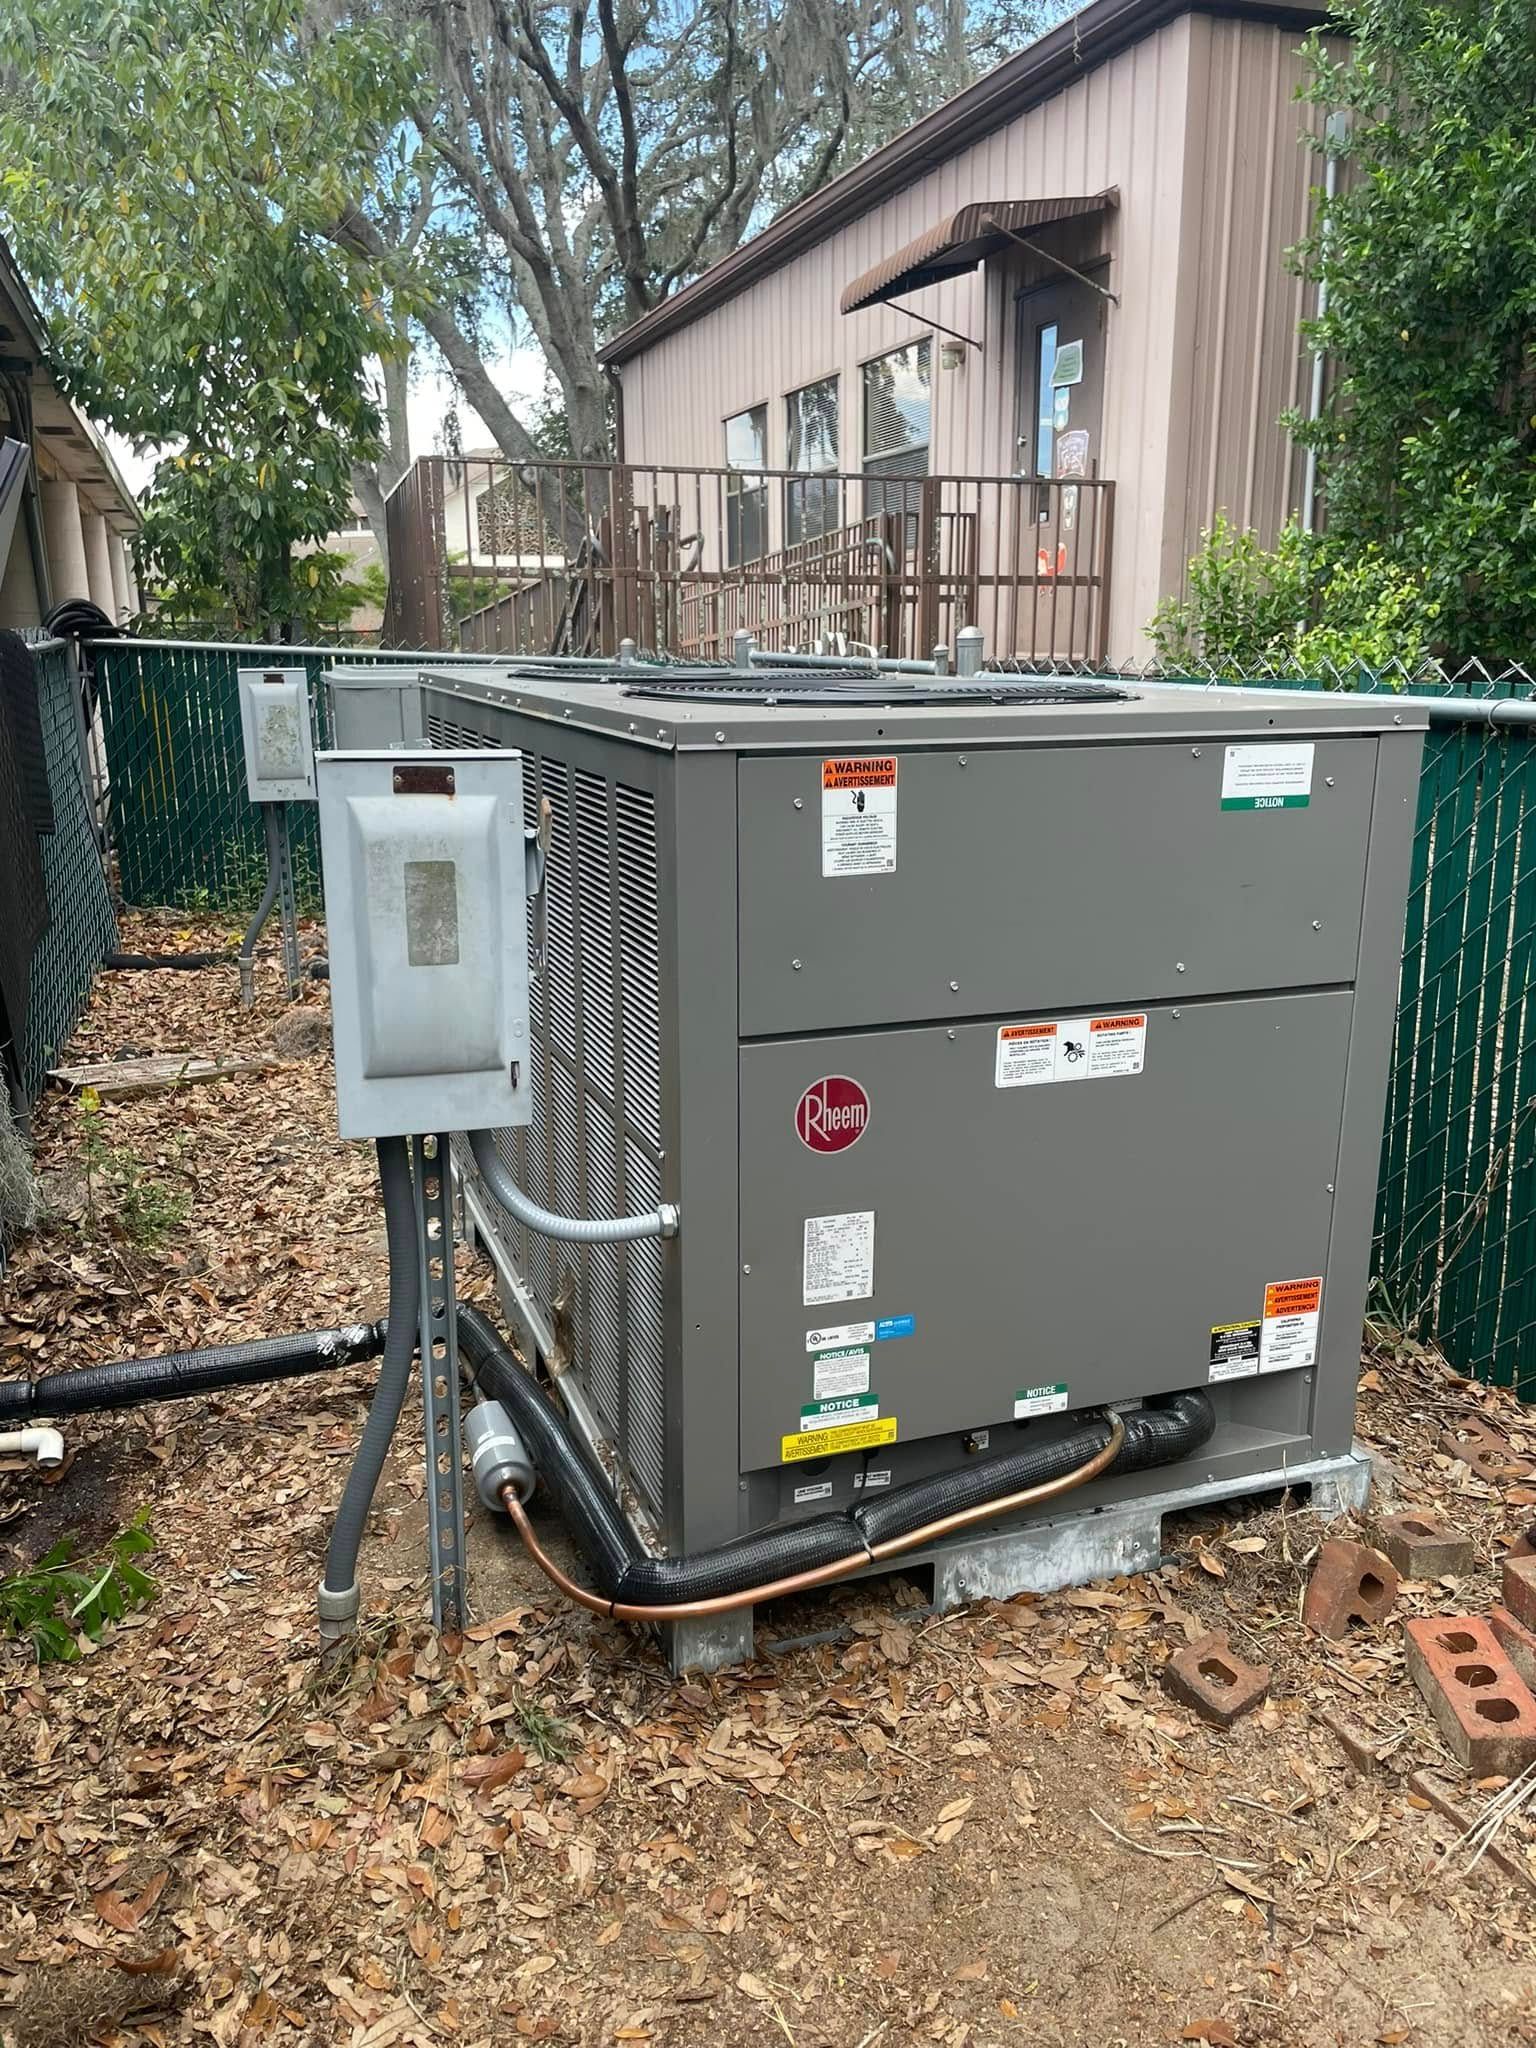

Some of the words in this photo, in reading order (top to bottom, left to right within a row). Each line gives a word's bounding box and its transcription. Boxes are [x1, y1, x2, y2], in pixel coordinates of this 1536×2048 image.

[834, 760, 893, 774] WARNING
[833, 774, 895, 788] AVERTISSEMENT
[1254, 796, 1284, 809] NOTICE
[1102, 1018, 1140, 1029] WARNING
[805, 1080, 865, 1142] Rheem
[1275, 1280, 1320, 1293] WARNING
[1274, 1290, 1318, 1304] AVERTISSEMENT
[1276, 1303, 1316, 1315] ADVERTENCIA
[1026, 1385, 1057, 1398] NOTICE
[819, 1398, 860, 1413] NOTICE
